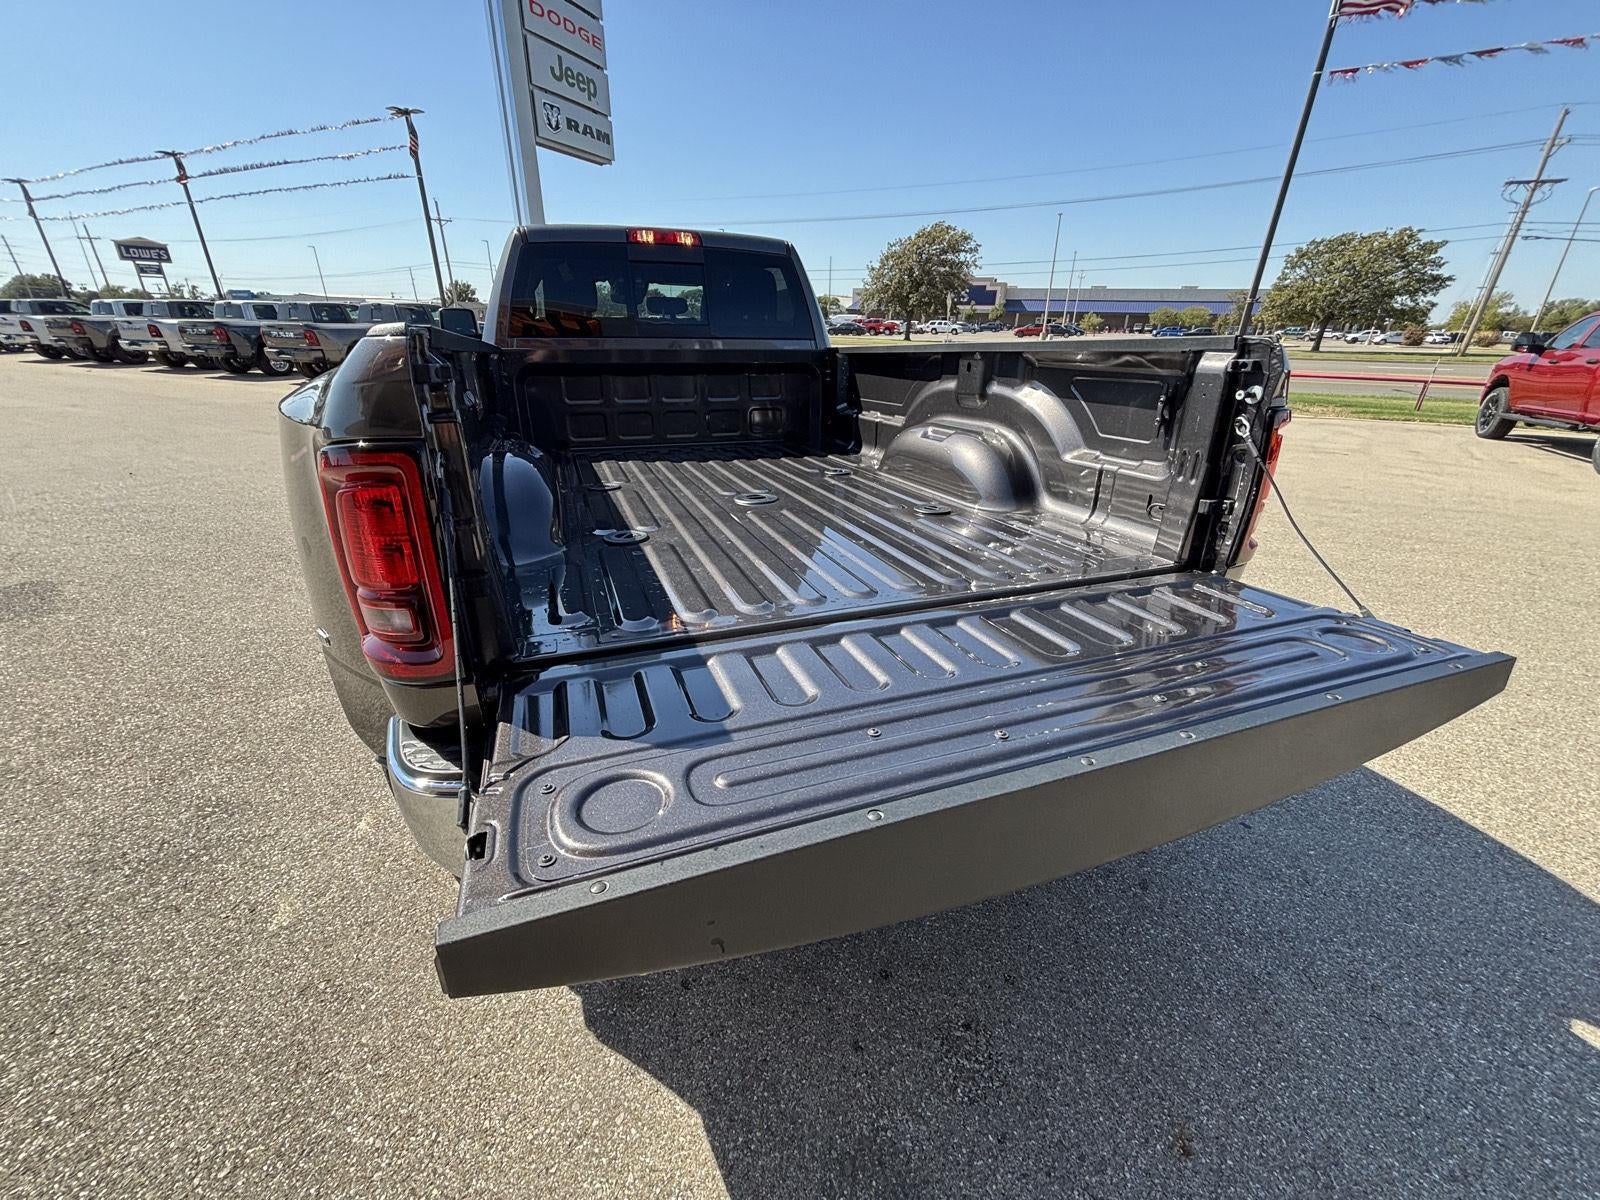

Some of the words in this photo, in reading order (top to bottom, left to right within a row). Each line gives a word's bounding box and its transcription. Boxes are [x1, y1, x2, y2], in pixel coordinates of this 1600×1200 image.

[529, 0, 603, 50] DODGE
[550, 54, 598, 101] Jeep
[566, 116, 611, 146] RAM
[121, 246, 168, 260] LOWE'S
